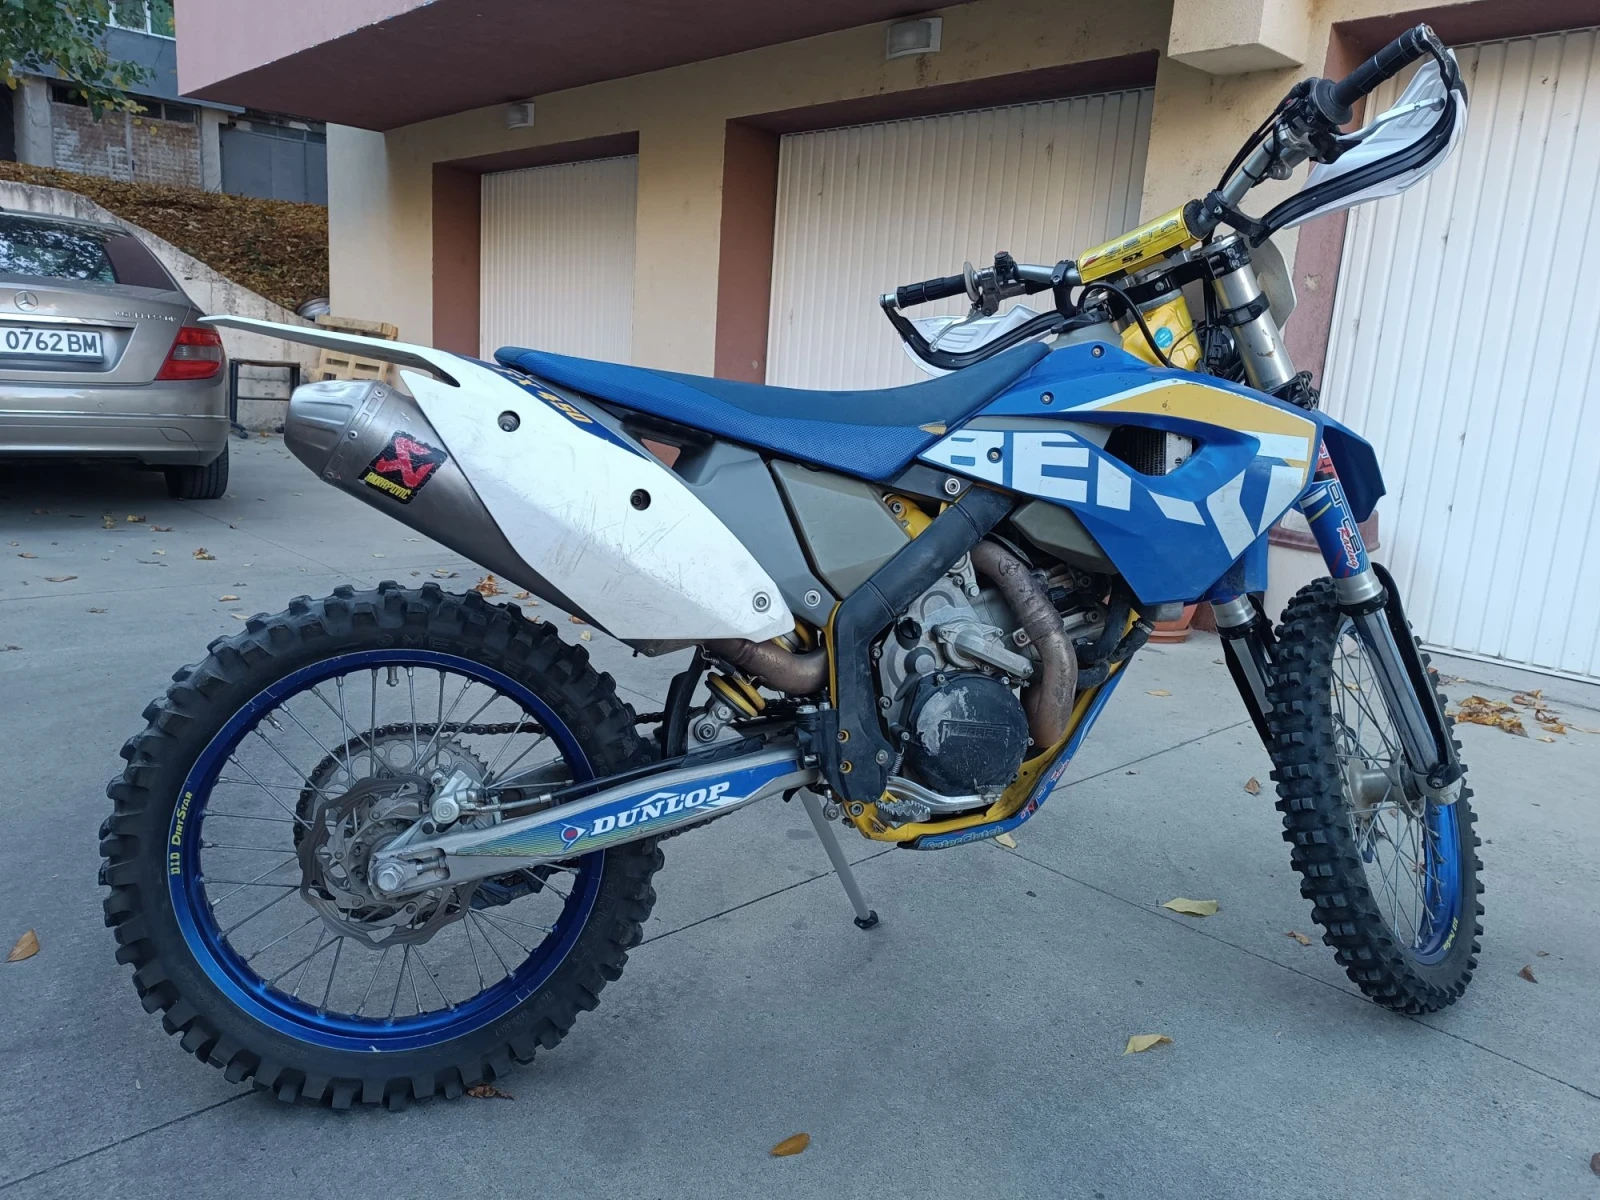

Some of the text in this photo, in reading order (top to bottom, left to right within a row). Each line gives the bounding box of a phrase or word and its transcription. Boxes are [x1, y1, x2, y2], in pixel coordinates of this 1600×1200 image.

[1121, 250, 1144, 265] SX
[5, 330, 98, 353] 0762 BM
[536, 390, 594, 424] 450
[1336, 526, 1360, 570] Racing
[589, 781, 731, 837] DUNLOP
